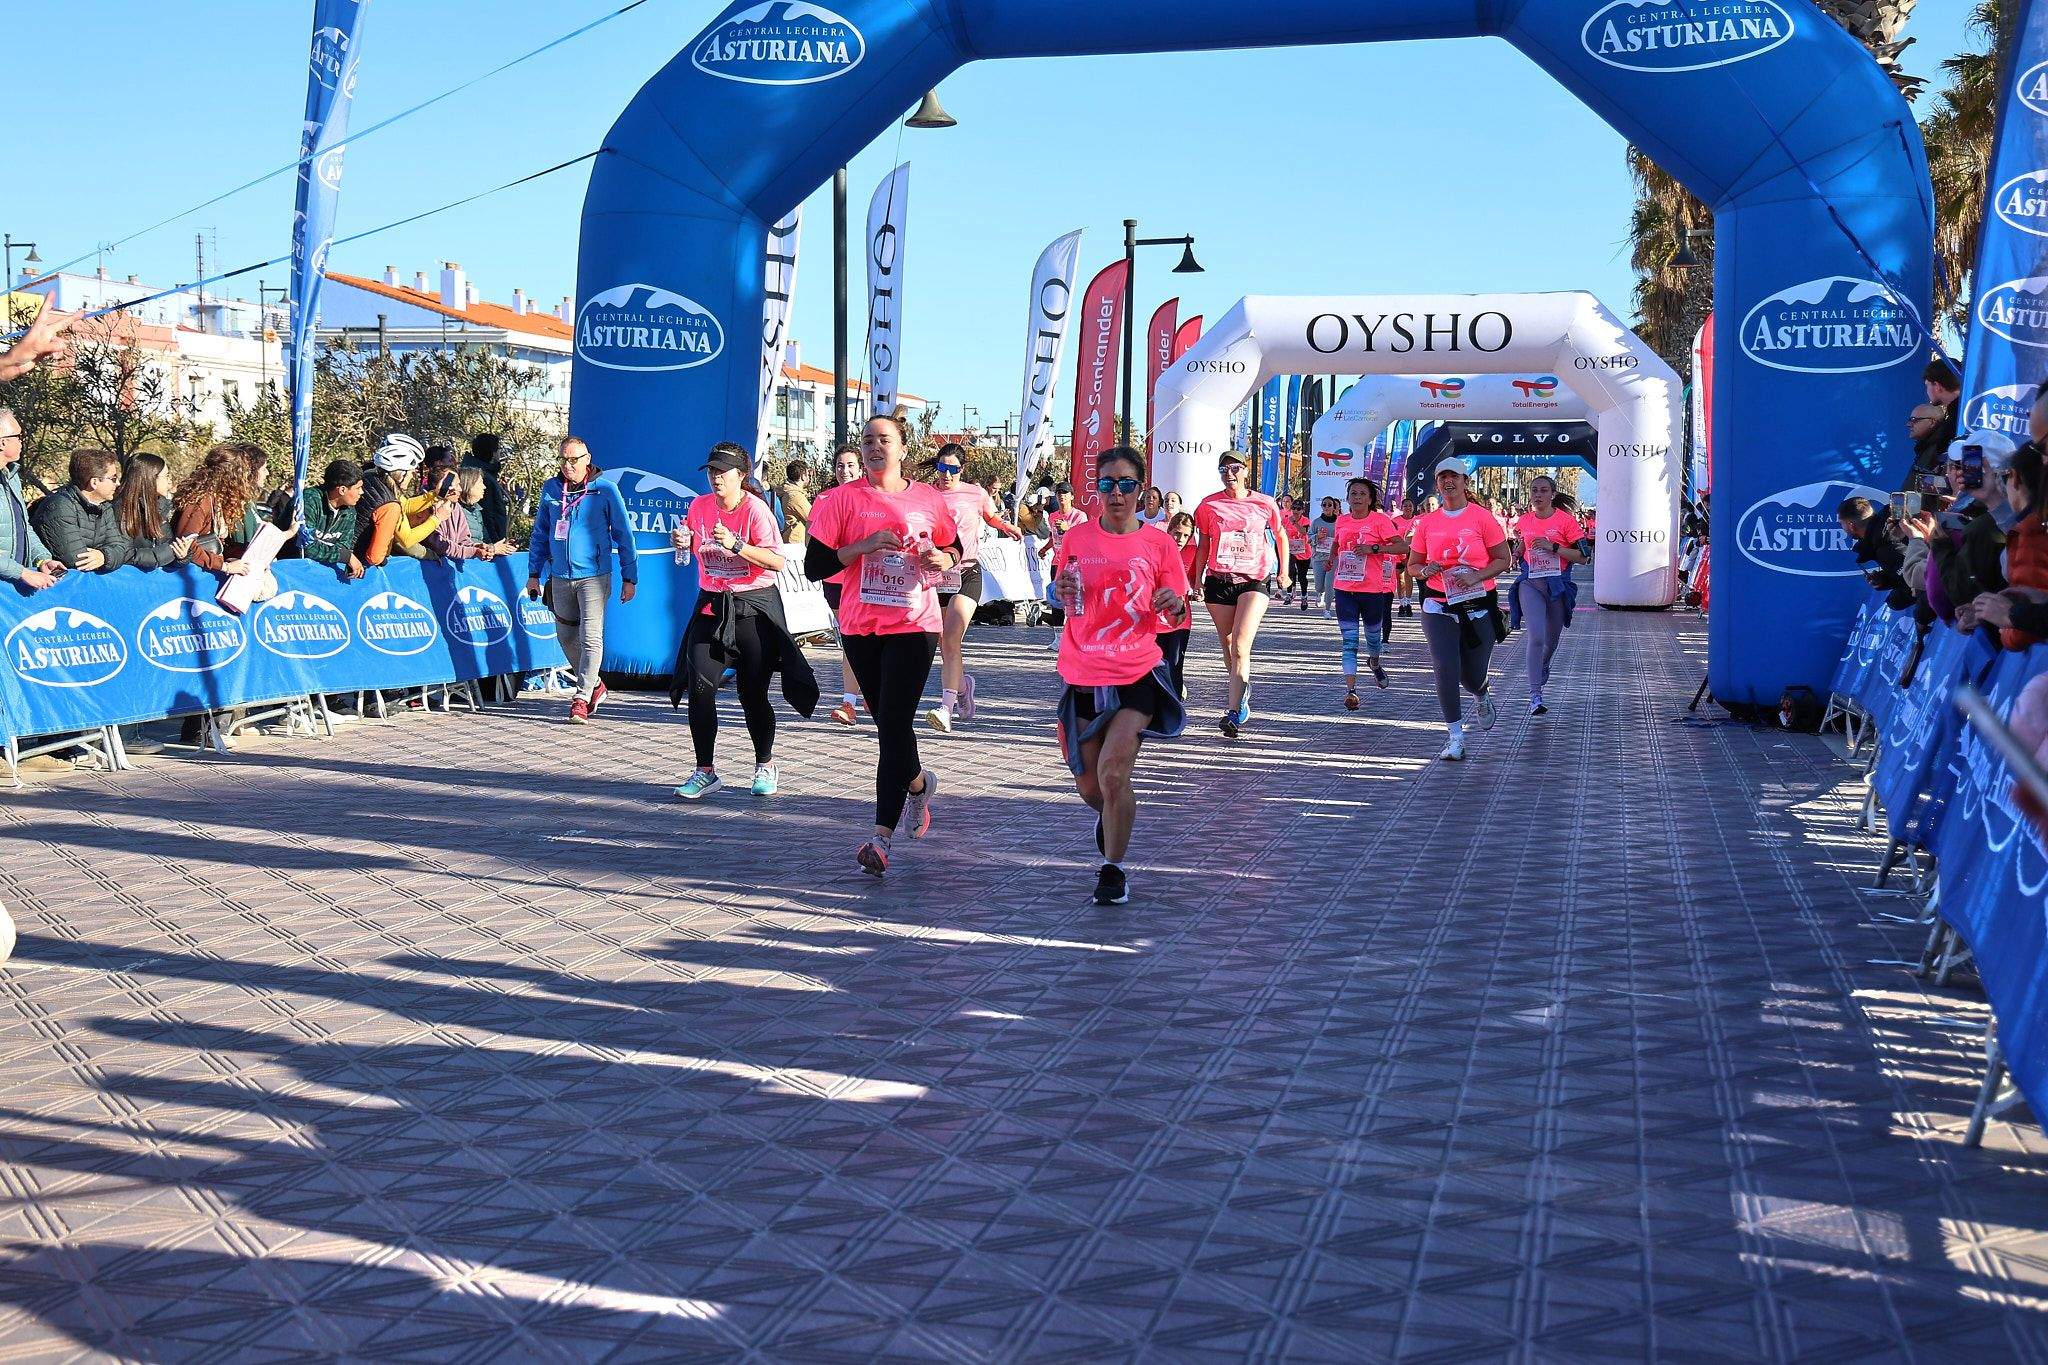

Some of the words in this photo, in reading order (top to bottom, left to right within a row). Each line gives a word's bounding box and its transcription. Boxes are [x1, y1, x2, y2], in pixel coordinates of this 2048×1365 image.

[1628, 8, 1697, 24] CENTRAL
[1704, 5, 1770, 16] LECHERA
[729, 26, 781, 38] CENTRAL
[786, 26, 846, 37] LECHERA
[1598, 17, 1782, 54] ASTURIANA
[700, 34, 851, 64] ASTURIANA
[596, 313, 645, 323] CENTRAL
[650, 314, 708, 328] LECHERA
[1780, 309, 1847, 321] CENTRAL
[1853, 308, 1908, 319] LECHER
[579, 315, 713, 354] ASTURIANA
[1306, 312, 1513, 354] OYSHO
[1750, 314, 1915, 351] ASTURIANA
[1089, 296, 1114, 405] Santander
[1186, 360, 1246, 375] OYSHO
[1574, 356, 1640, 371] OYSHO
[1511, 401, 1559, 409] TotalEnergies
[1467, 433, 1570, 444] VOLVO
[1158, 441, 1213, 455] OYSHO
[1608, 444, 1668, 458] OYSHO
[1606, 529, 1666, 543] OYSHO
[1747, 515, 1856, 551] ASTUR
[882, 574, 905, 586] 016
[275, 613, 309, 622] CENTRAL
[310, 613, 338, 621] LECHERA
[160, 623, 195, 633] CENTRAL
[263, 616, 347, 644] ASTURIANA
[365, 614, 433, 640] ASTURIANA
[34, 633, 74, 644] CENTRAL
[76, 631, 112, 641] LECHERA
[149, 628, 241, 658] ASTURIANA
[18, 639, 122, 671] ASTURIANA
